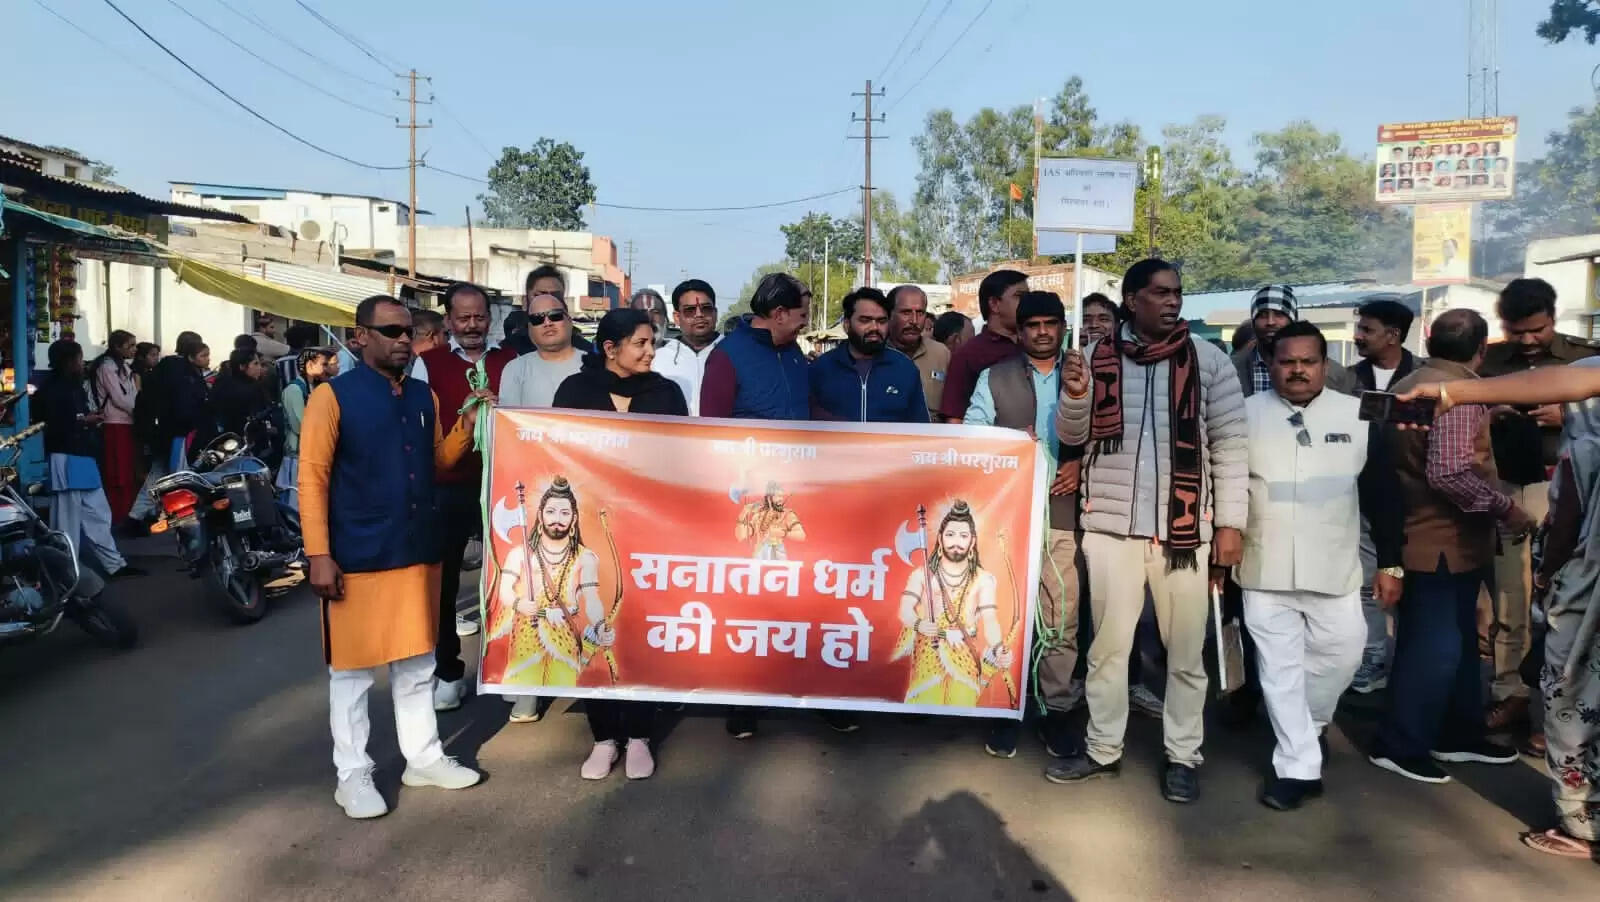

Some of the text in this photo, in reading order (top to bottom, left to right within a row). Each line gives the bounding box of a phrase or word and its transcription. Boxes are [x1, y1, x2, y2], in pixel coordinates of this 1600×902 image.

[1044, 168, 1061, 177] IAS
[911, 447, 1019, 475] जय श्री परशुराम
[630, 547, 892, 600] सनातन धर्म
[646, 601, 874, 668] की जय हो
